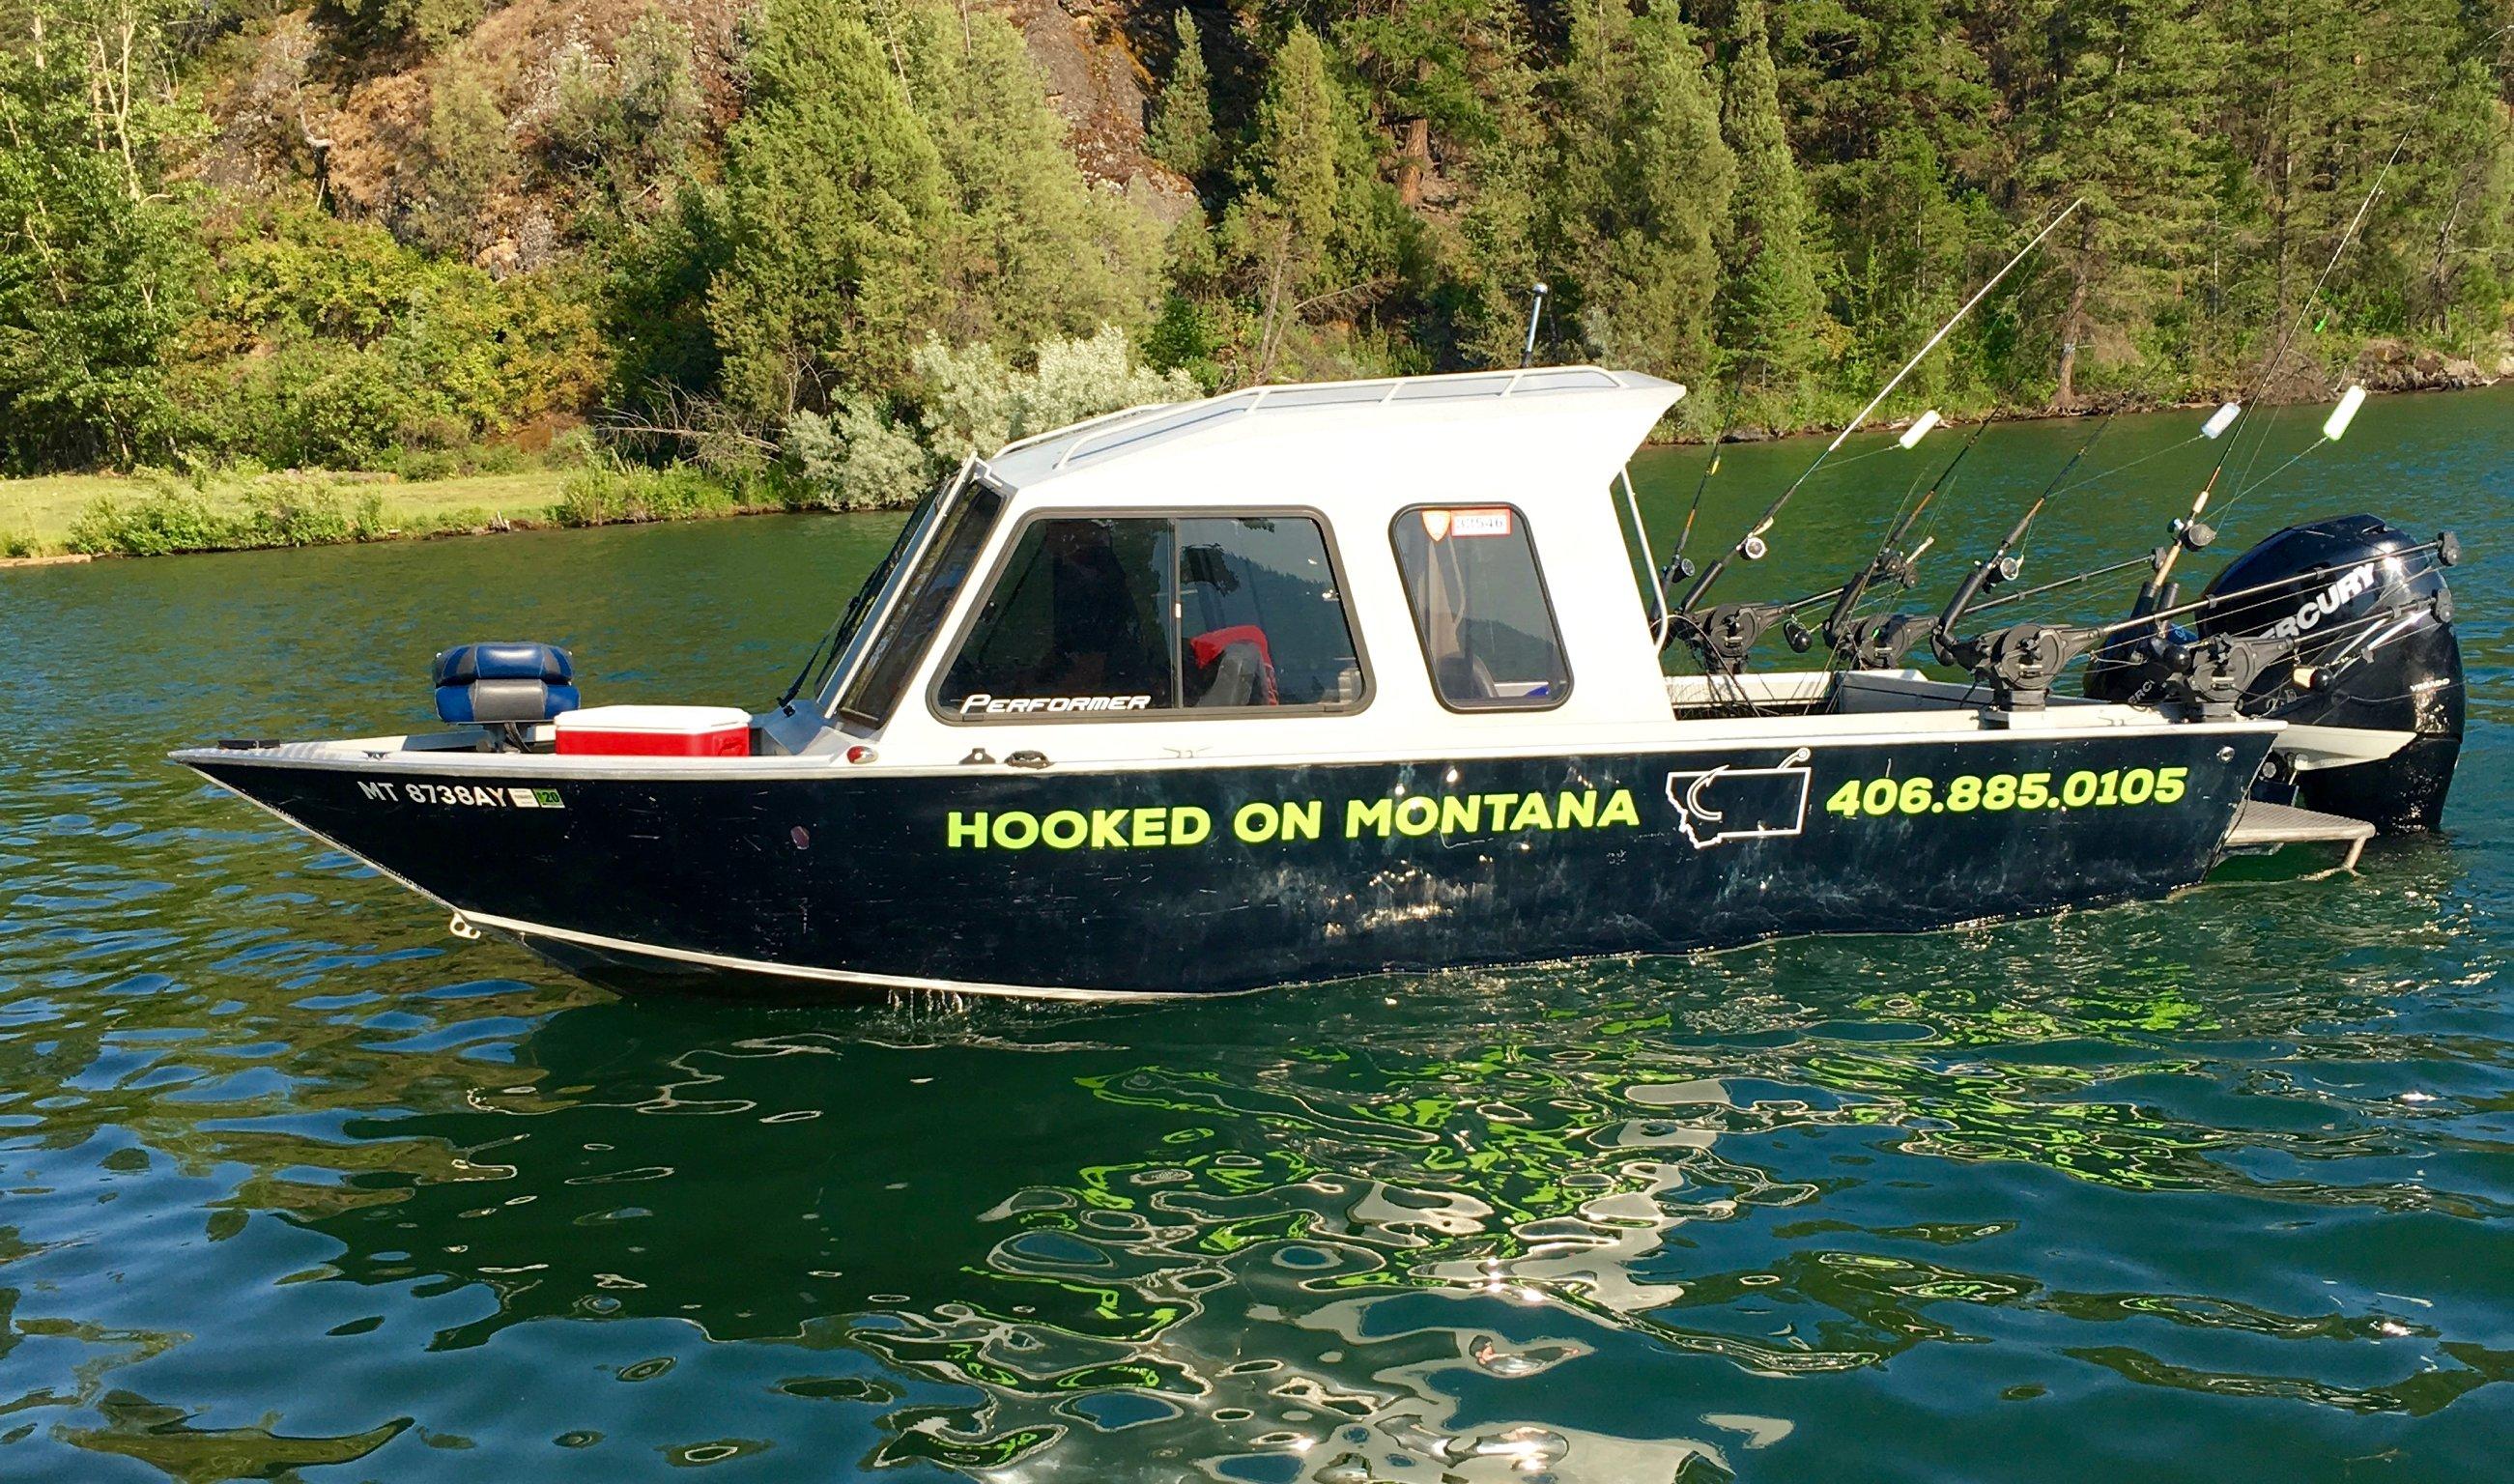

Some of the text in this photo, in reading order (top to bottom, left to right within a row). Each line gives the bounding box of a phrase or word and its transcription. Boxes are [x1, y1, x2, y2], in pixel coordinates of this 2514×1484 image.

[2259, 562, 2375, 639] RCURY
[960, 694, 1152, 714] PERFORMER
[357, 781, 399, 802] MT
[405, 784, 507, 808] 8738AY
[1826, 767, 2188, 816] 406.885.0105
[948, 789, 1641, 849] HOOKED ON MONTANA
